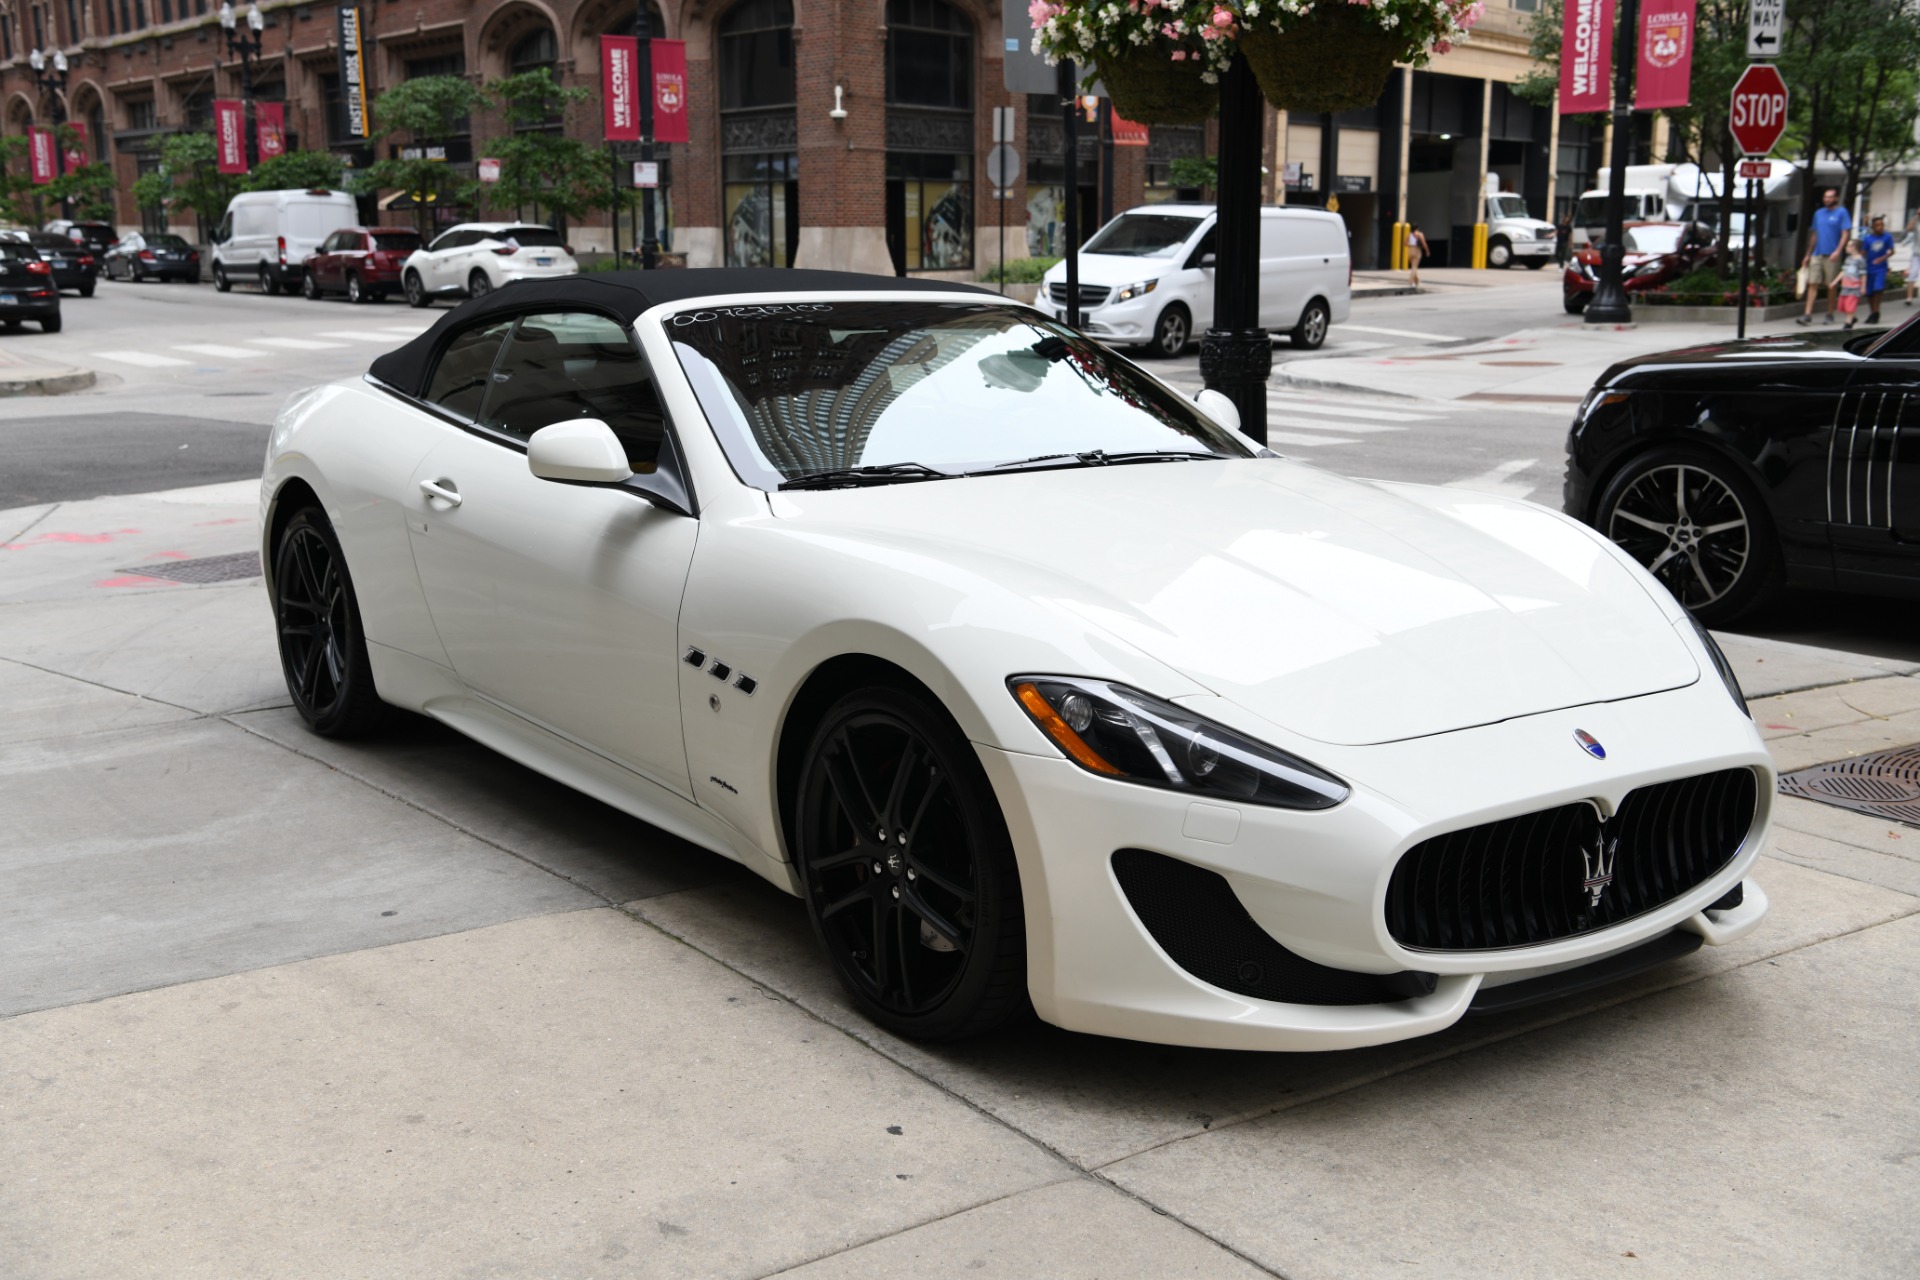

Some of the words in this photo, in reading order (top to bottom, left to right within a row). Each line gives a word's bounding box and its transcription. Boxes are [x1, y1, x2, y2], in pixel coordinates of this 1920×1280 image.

[342, 8, 359, 51] BAGELS
[1647, 12, 1688, 25] LOYOLA
[1754, 10, 1780, 27] WAY
[1590, 31, 1600, 62] TOWER
[611, 48, 624, 128] WELCOME
[348, 85, 364, 136] EINSTEIN
[1734, 93, 1784, 128] STOP
[221, 109, 235, 165] WELCOME
[1757, 165, 1769, 176] WAY
